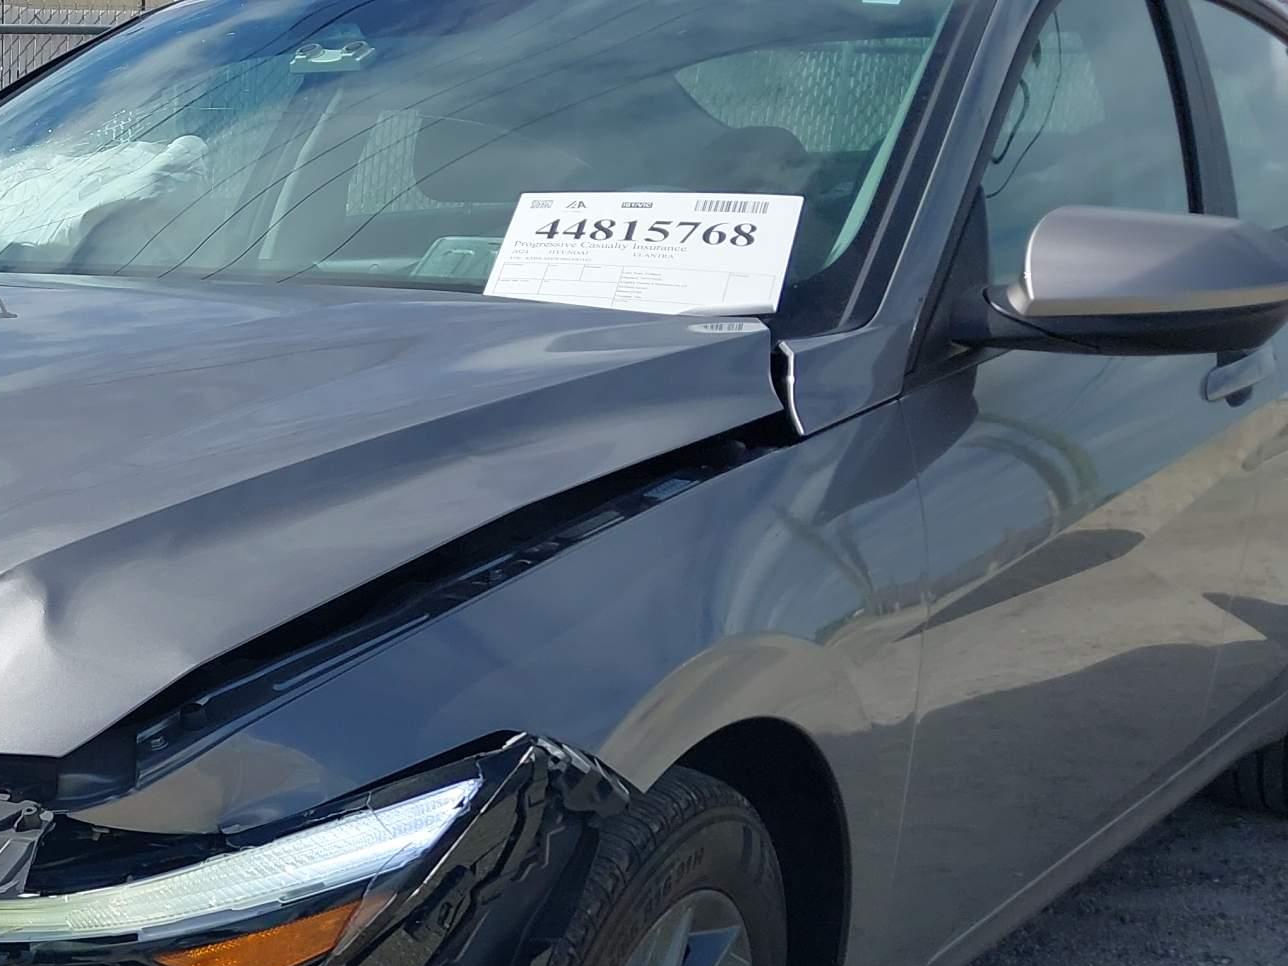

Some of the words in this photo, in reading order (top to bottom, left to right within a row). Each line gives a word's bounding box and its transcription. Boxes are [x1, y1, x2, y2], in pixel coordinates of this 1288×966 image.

[535, 218, 758, 247] 44815768
[514, 240, 577, 248] Progressive
[580, 241, 627, 249] Casualty
[632, 243, 687, 252] Insurance
